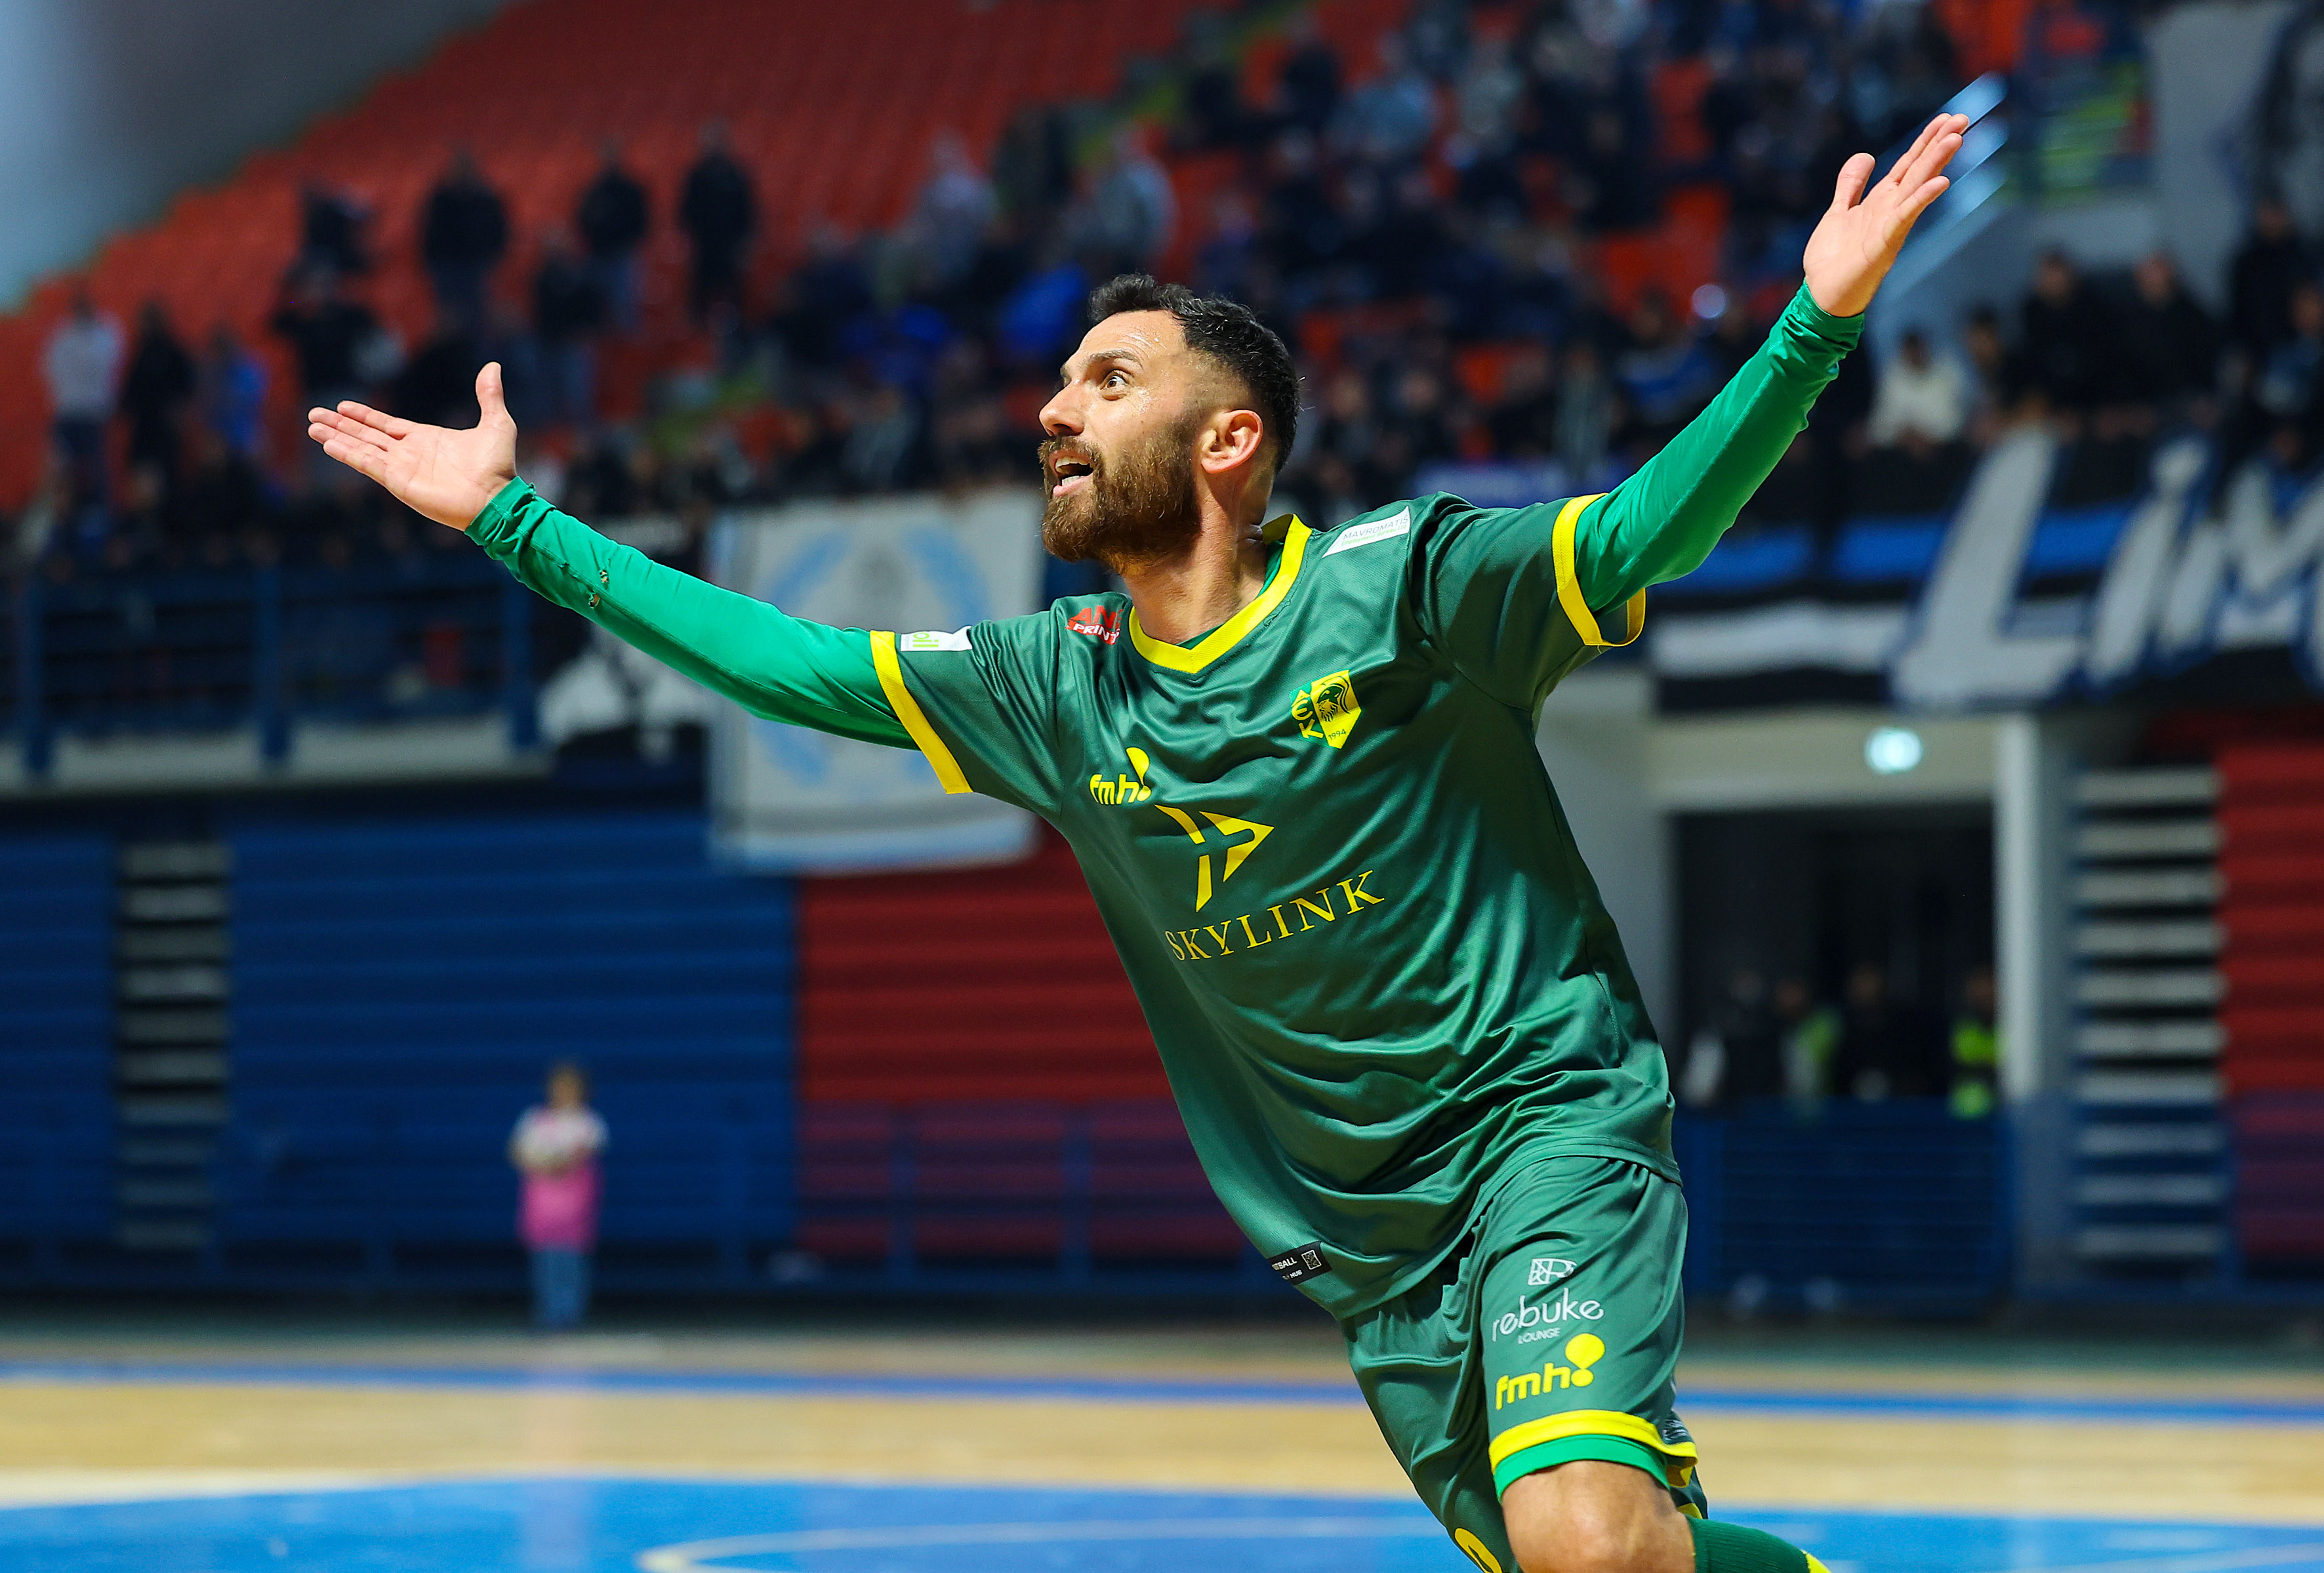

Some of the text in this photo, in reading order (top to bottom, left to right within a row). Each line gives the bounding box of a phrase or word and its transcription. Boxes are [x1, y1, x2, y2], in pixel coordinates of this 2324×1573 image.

[1343, 515, 1408, 540] MAVROMATIS
[1073, 623, 1120, 644] PRINT
[1328, 729, 1347, 740] 1994
[1165, 870, 1385, 960] SKYLINK
[1492, 1287, 1604, 1342] rebuke
[1518, 1327, 1560, 1344] LOUNGE
